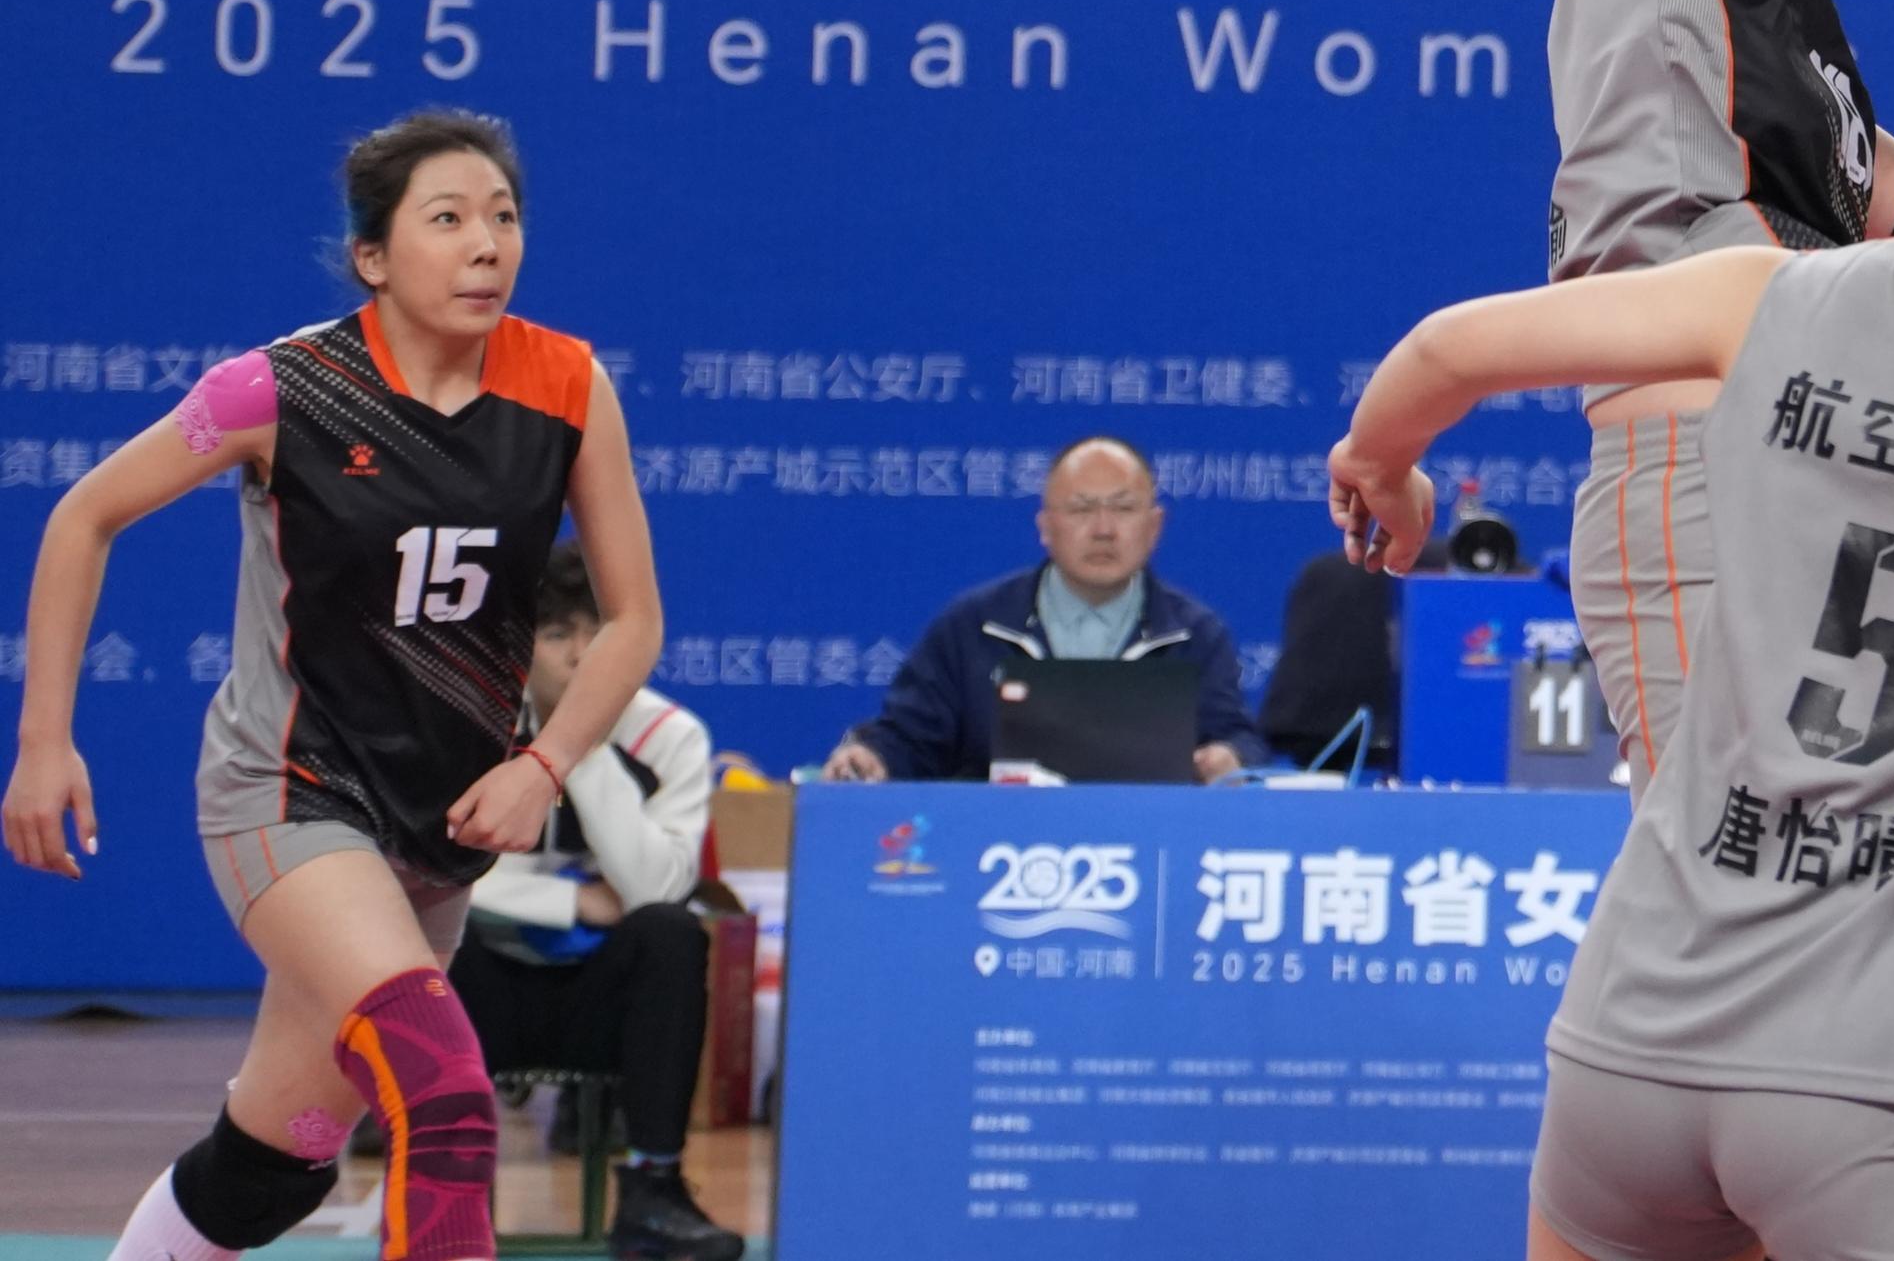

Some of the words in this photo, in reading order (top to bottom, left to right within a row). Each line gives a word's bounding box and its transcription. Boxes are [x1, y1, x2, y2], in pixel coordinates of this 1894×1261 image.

[1177, 7, 1510, 96] Wom
[395, 526, 497, 627] 15
[1529, 677, 1584, 746] 11
[977, 842, 1141, 911] 2025
[1196, 846, 1599, 947] 河南省女
[1193, 952, 1302, 983] 2025
[1332, 955, 1477, 985] Henan
